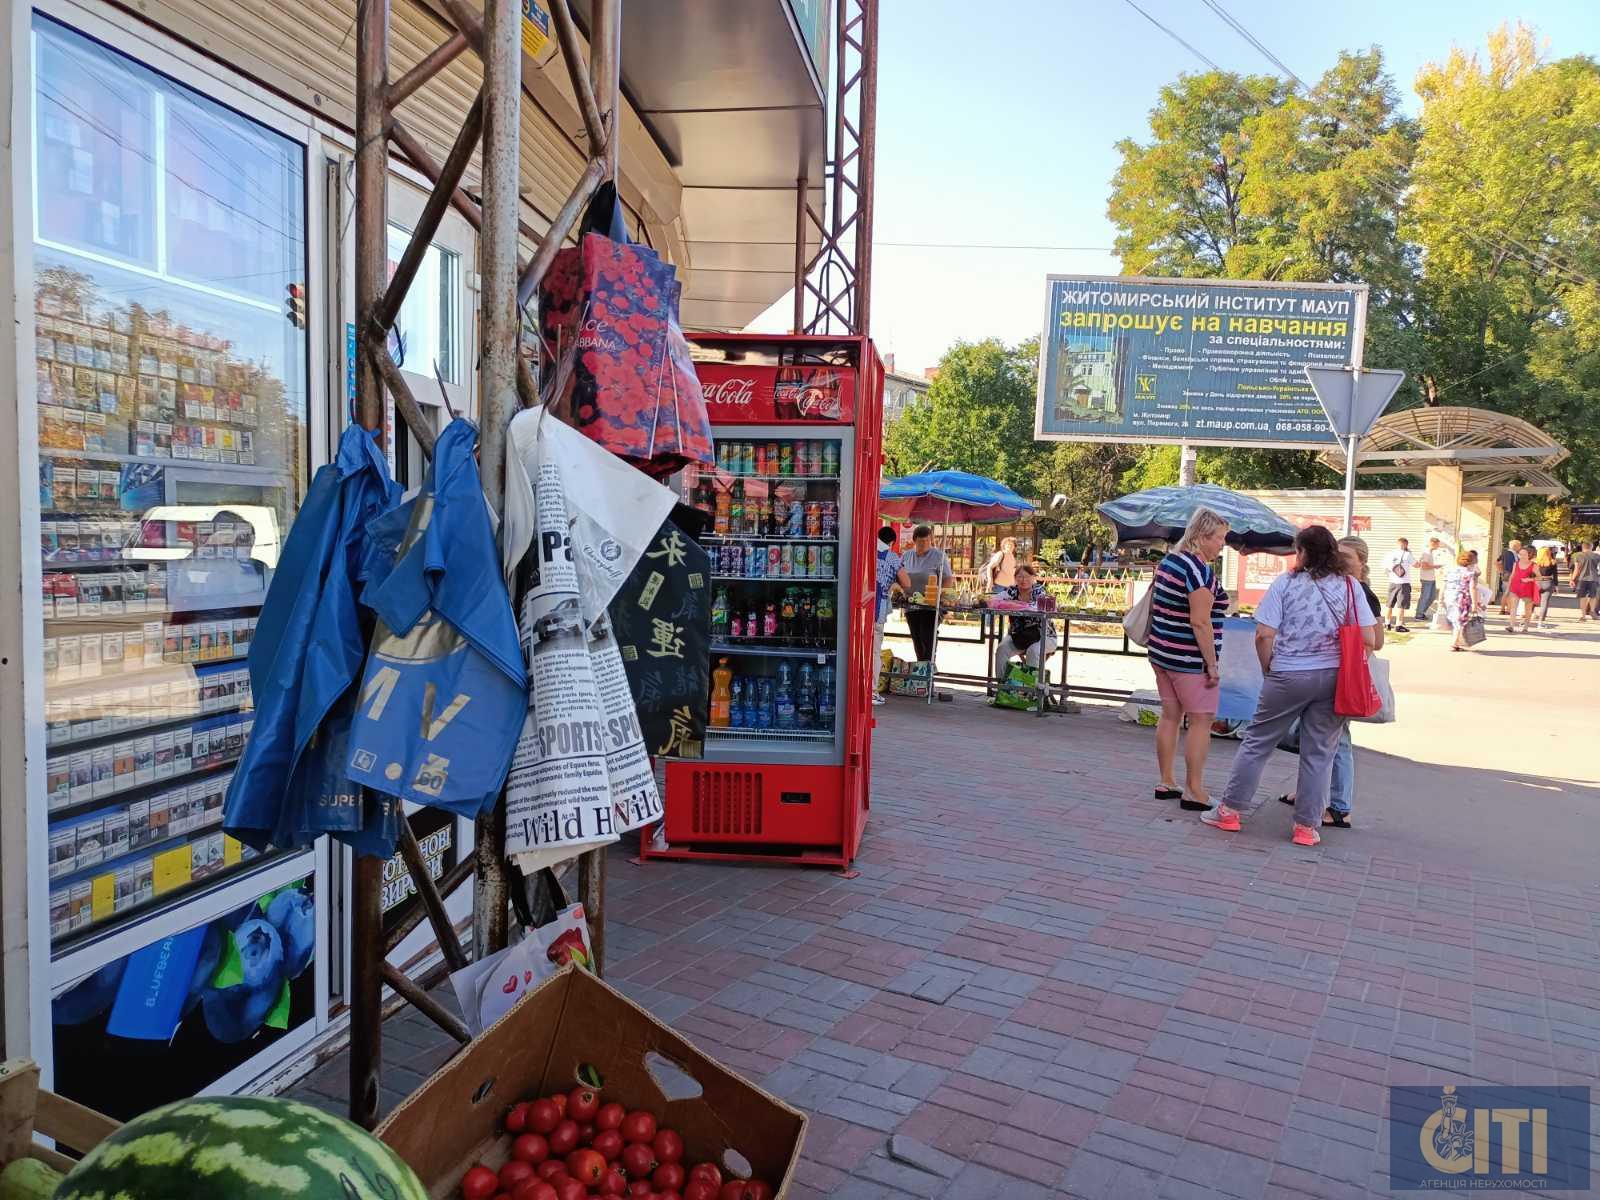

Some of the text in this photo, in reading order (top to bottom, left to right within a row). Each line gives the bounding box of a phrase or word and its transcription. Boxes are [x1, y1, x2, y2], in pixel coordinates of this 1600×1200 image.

[1061, 290, 1350, 315] ЖИТОМИРСЬКИЙ ІНСТИТУТ МАУП
[1060, 311, 1184, 335] запрошує
[1191, 316, 1220, 332] на
[1229, 317, 1348, 337] навчання
[1208, 334, 1346, 350] за спеціальностями:
[540, 720, 603, 758] SPORTS
[522, 806, 585, 847] Wild
